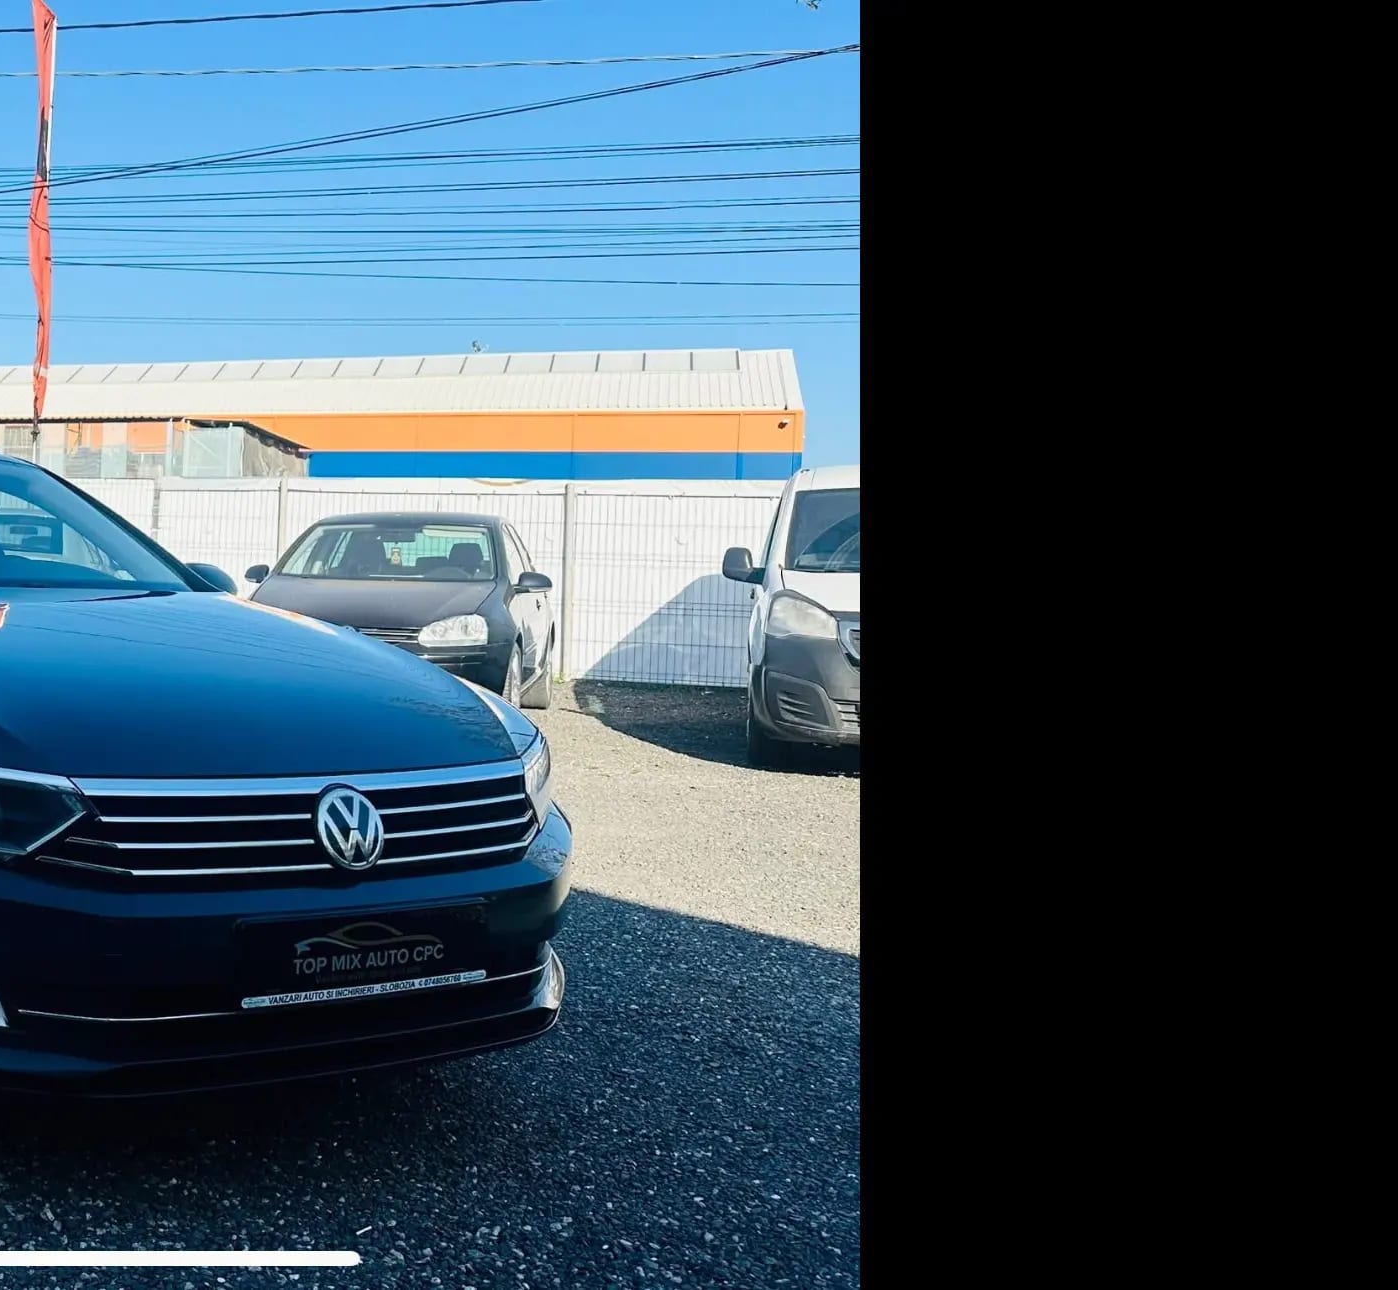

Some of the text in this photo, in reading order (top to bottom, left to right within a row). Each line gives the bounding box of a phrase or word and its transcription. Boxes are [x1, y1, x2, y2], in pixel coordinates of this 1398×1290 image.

[318, 789, 383, 869] VW
[293, 957, 327, 976] TOP
[331, 953, 362, 972] MIX
[365, 948, 409, 968] AUTO
[413, 944, 444, 961] CPC
[268, 993, 303, 1005] VANZARI
[303, 990, 325, 1001] AUTO
[326, 989, 334, 999] SI
[335, 985, 375, 998] INCHIRIERI
[380, 980, 416, 993] SLOBOZIA
